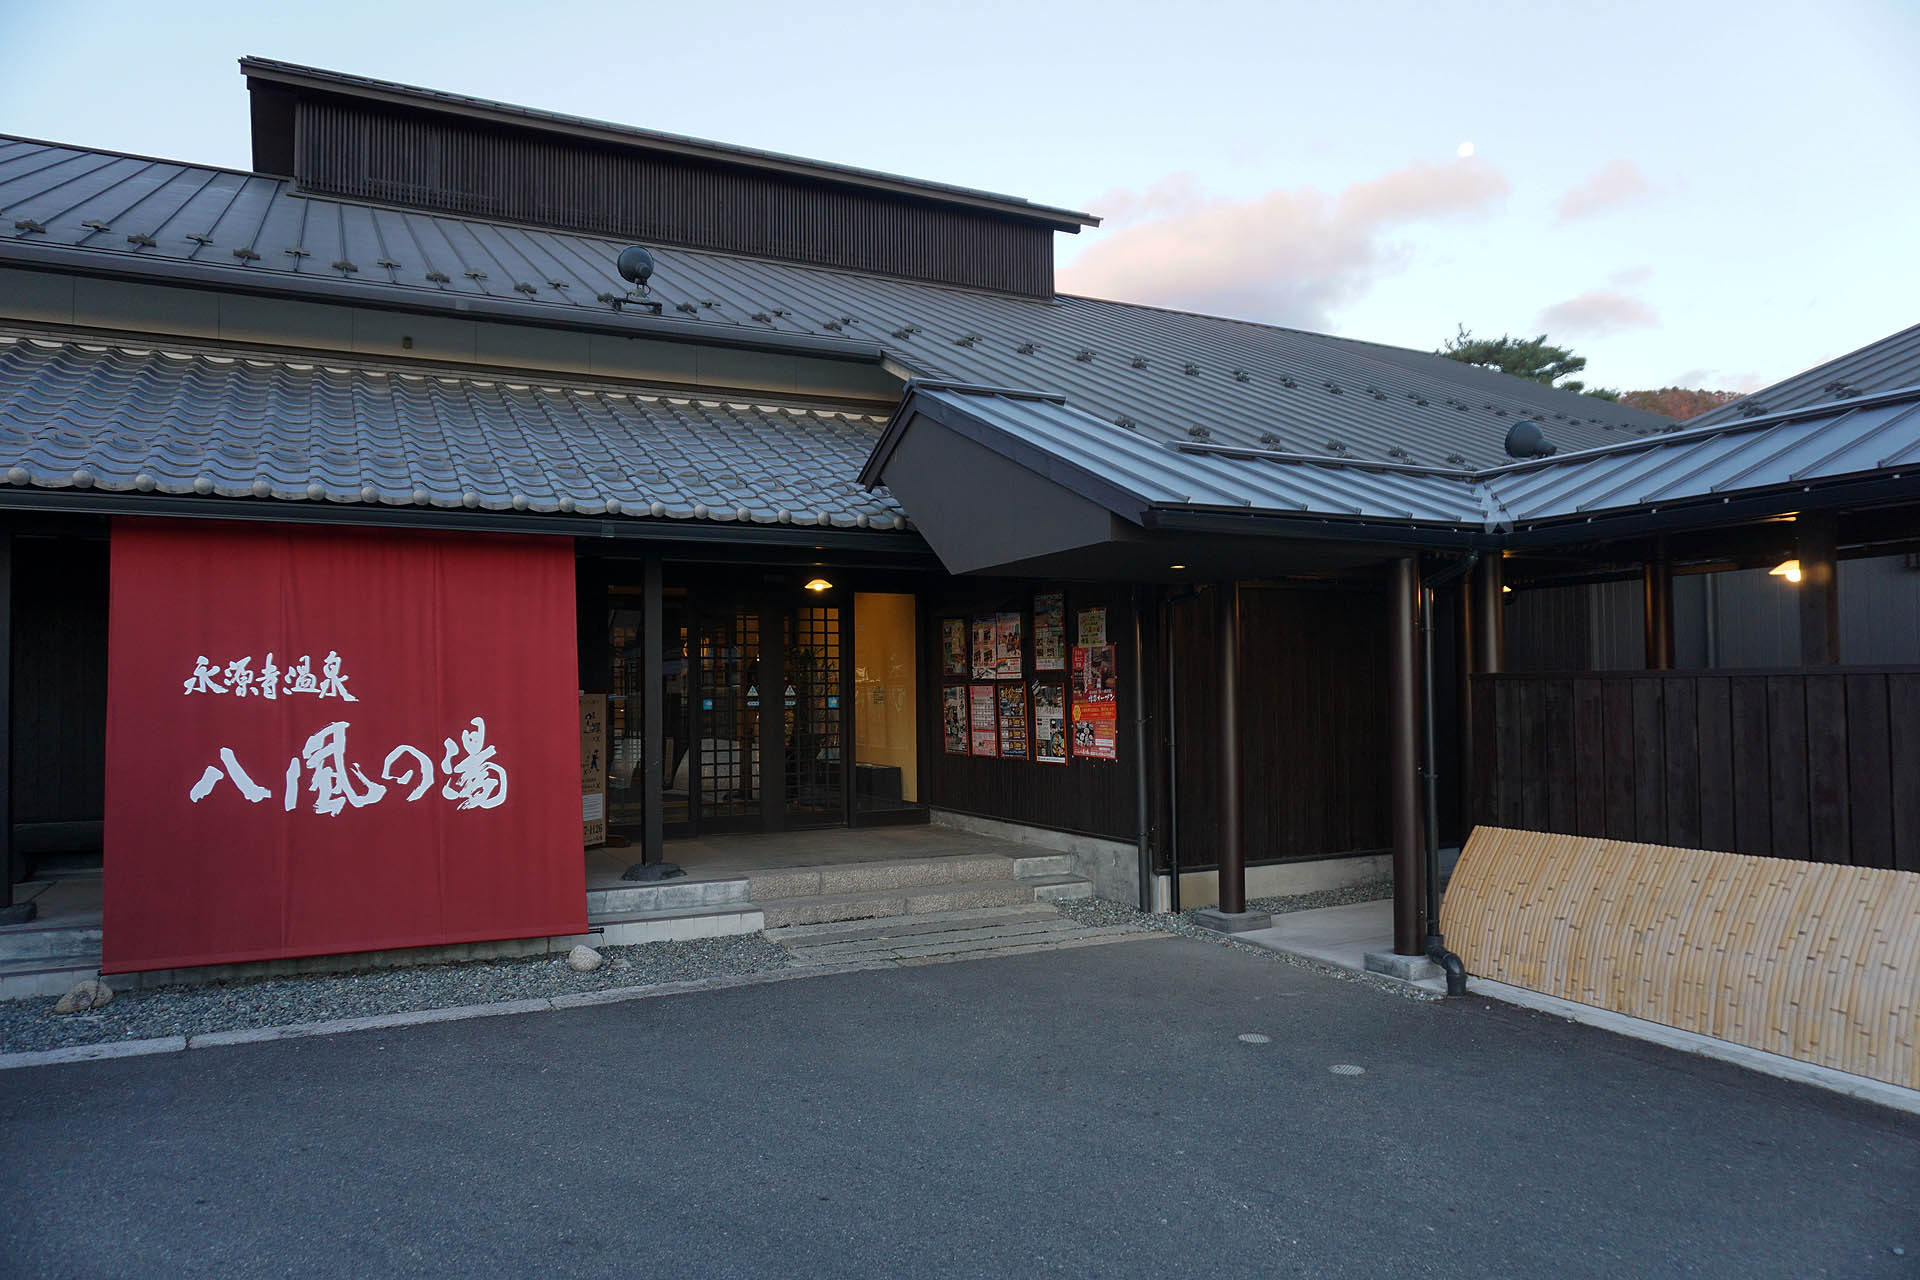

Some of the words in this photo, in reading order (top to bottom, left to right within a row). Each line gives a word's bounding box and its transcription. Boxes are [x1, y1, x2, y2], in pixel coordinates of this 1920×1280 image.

[184, 650, 359, 702] 永源寺温泉
[189, 717, 507, 817] 八風の湯
